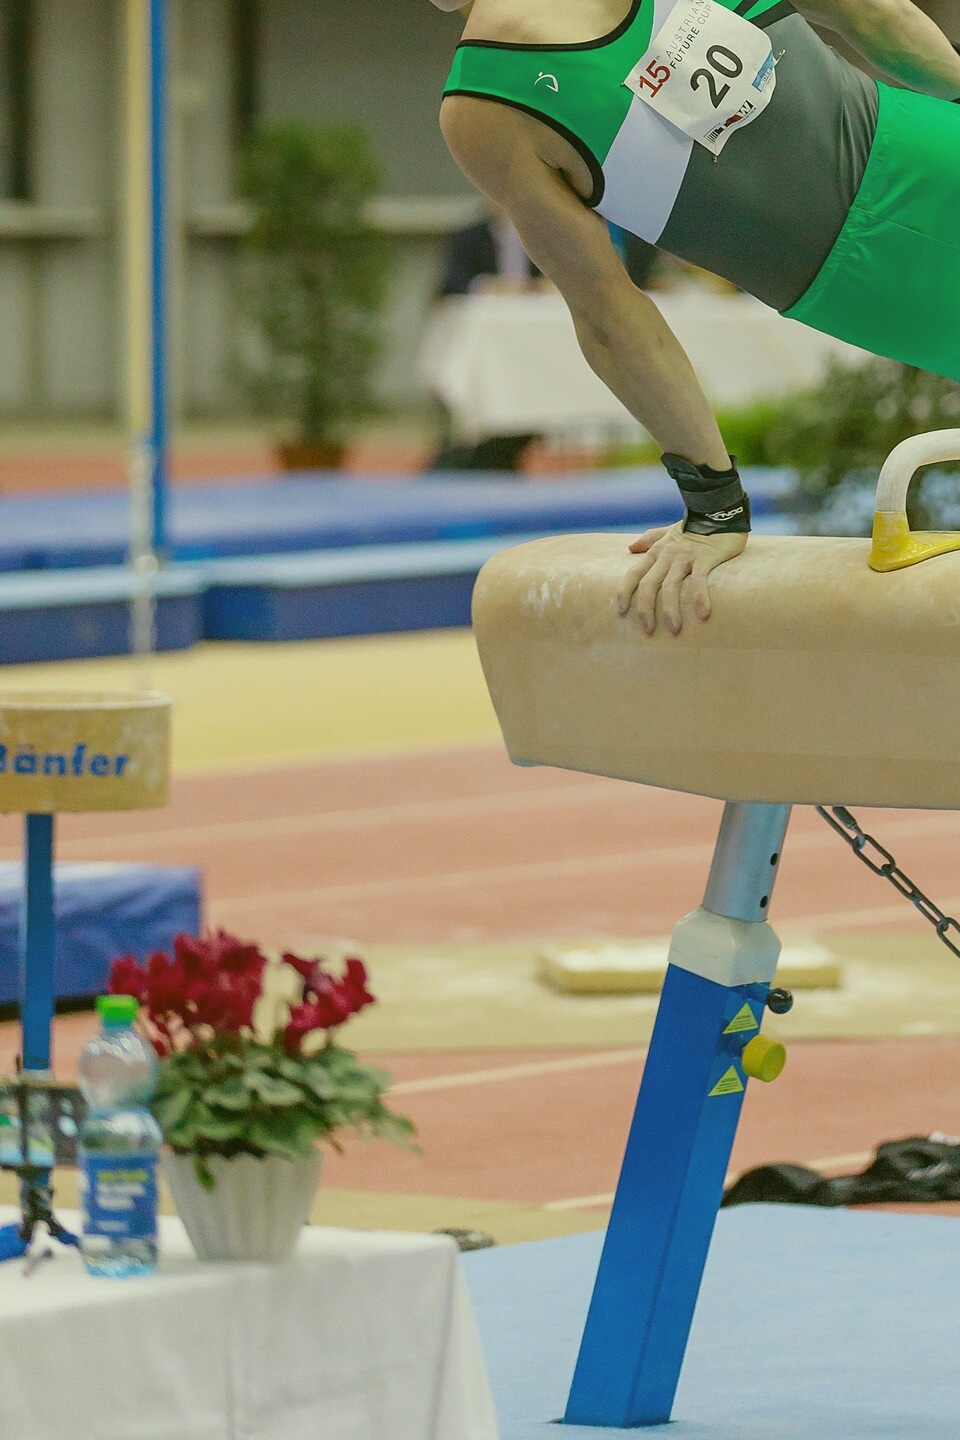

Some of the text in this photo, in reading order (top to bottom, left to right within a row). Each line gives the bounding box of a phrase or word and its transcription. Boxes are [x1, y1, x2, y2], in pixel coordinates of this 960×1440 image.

[669, 4, 712, 69] FUTURE CUP
[690, 45, 743, 109] 20
